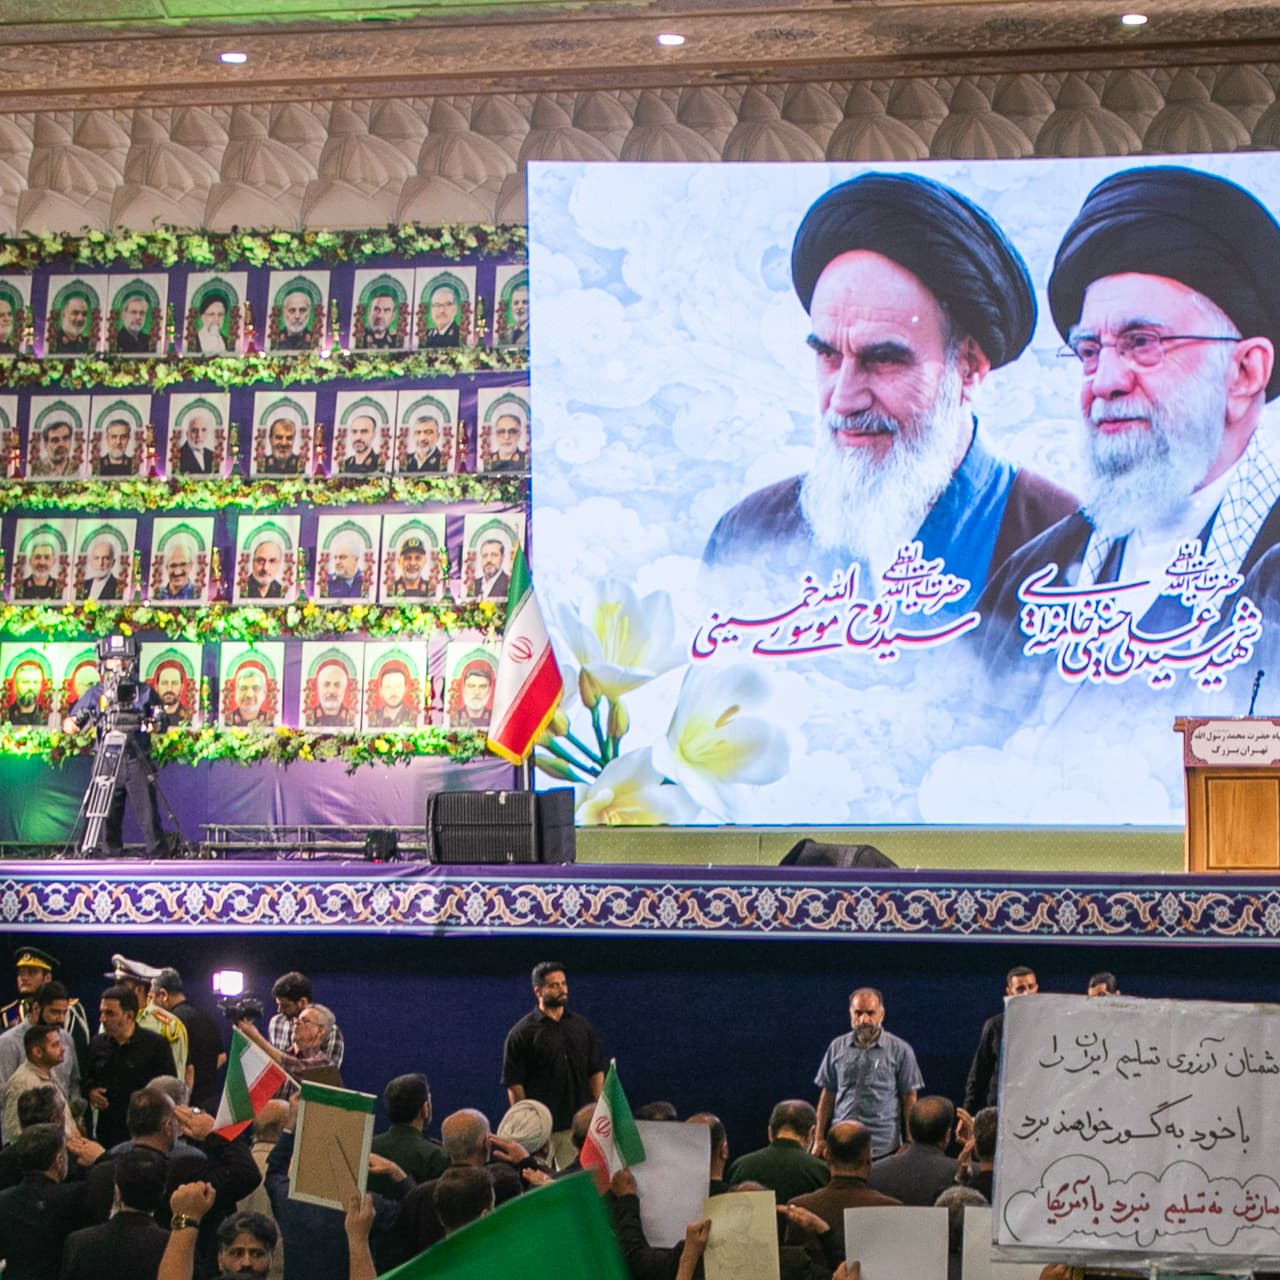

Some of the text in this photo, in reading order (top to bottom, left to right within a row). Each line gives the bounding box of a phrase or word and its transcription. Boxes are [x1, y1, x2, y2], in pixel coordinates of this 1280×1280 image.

[692, 566, 977, 659] سید روح الله موسوی خمینی
[1105, 608, 1216, 676] علی
[1133, 629, 1238, 684] سید
[1194, 731, 1206, 739] الله
[1206, 731, 1226, 741] رسول
[1211, 745, 1268, 756] تهران بزرگ
[1247, 732, 1270, 742] حضرت
[1038, 1034, 1065, 1068] را
[1065, 1032, 1109, 1075] ایران
[1116, 1039, 1161, 1079] تسلیم
[1166, 1037, 1225, 1075] آرزوی
[1012, 1094, 1251, 1154] با خود به گور خواهند برد
[1046, 1174, 1092, 1225] آمریکا
[1089, 1185, 1104, 1225] با
[1111, 1192, 1151, 1224] نبرد
[1164, 1192, 1207, 1224] تسلیم
[1206, 1191, 1223, 1215] نه
[1232, 1189, 1278, 1222] سازش
